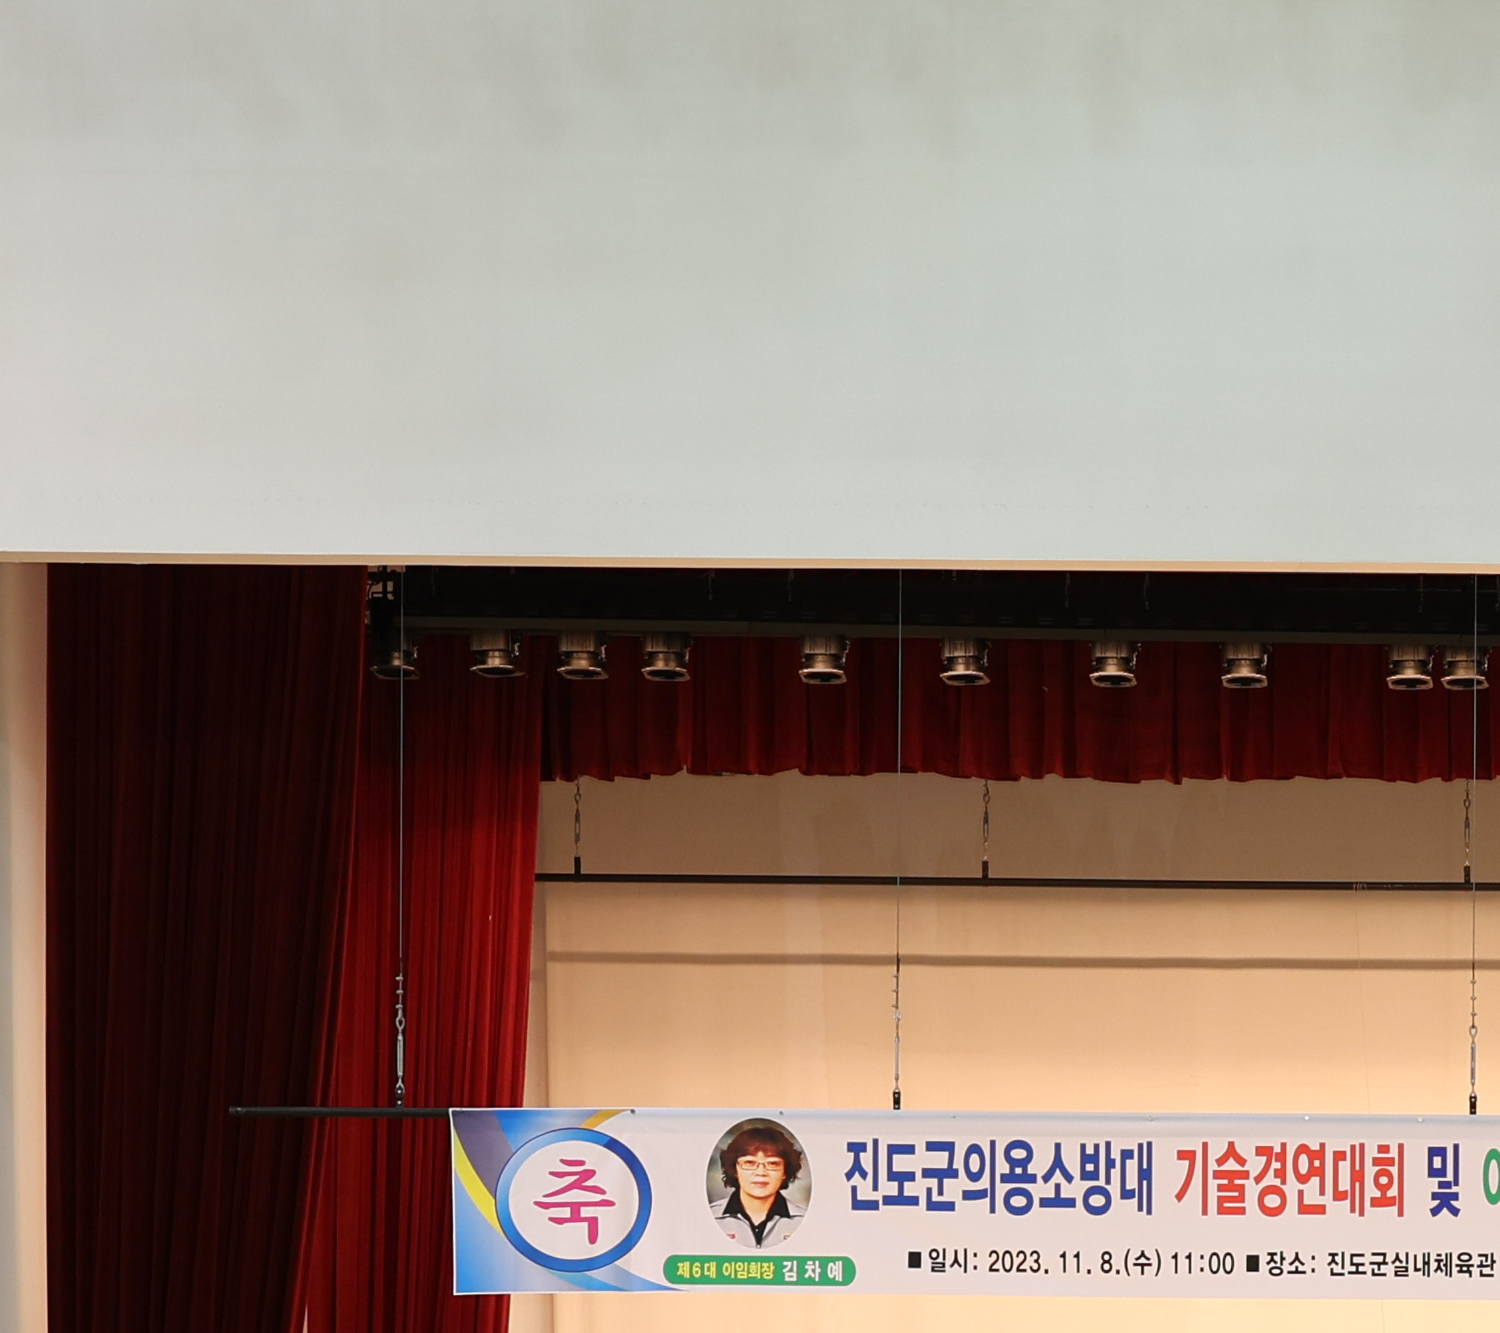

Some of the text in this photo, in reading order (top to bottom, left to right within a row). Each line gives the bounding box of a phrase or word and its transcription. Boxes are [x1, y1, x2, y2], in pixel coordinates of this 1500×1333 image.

[533, 1158, 616, 1246] 축
[844, 1138, 1153, 1216] 진도군의용소방대
[1175, 1140, 1404, 1218] 기술경연대회
[1427, 1142, 1461, 1218] 및
[677, 1261, 716, 1279] 제6대
[723, 1261, 775, 1280] 이임회장
[928, 1247, 979, 1275] 일시:
[987, 1249, 1050, 1275] 2023.
[1171, 1251, 1235, 1275] 11:00
[1266, 1250, 1317, 1277] 장소:
[1326, 1250, 1497, 1279] 진도군실내체육관
